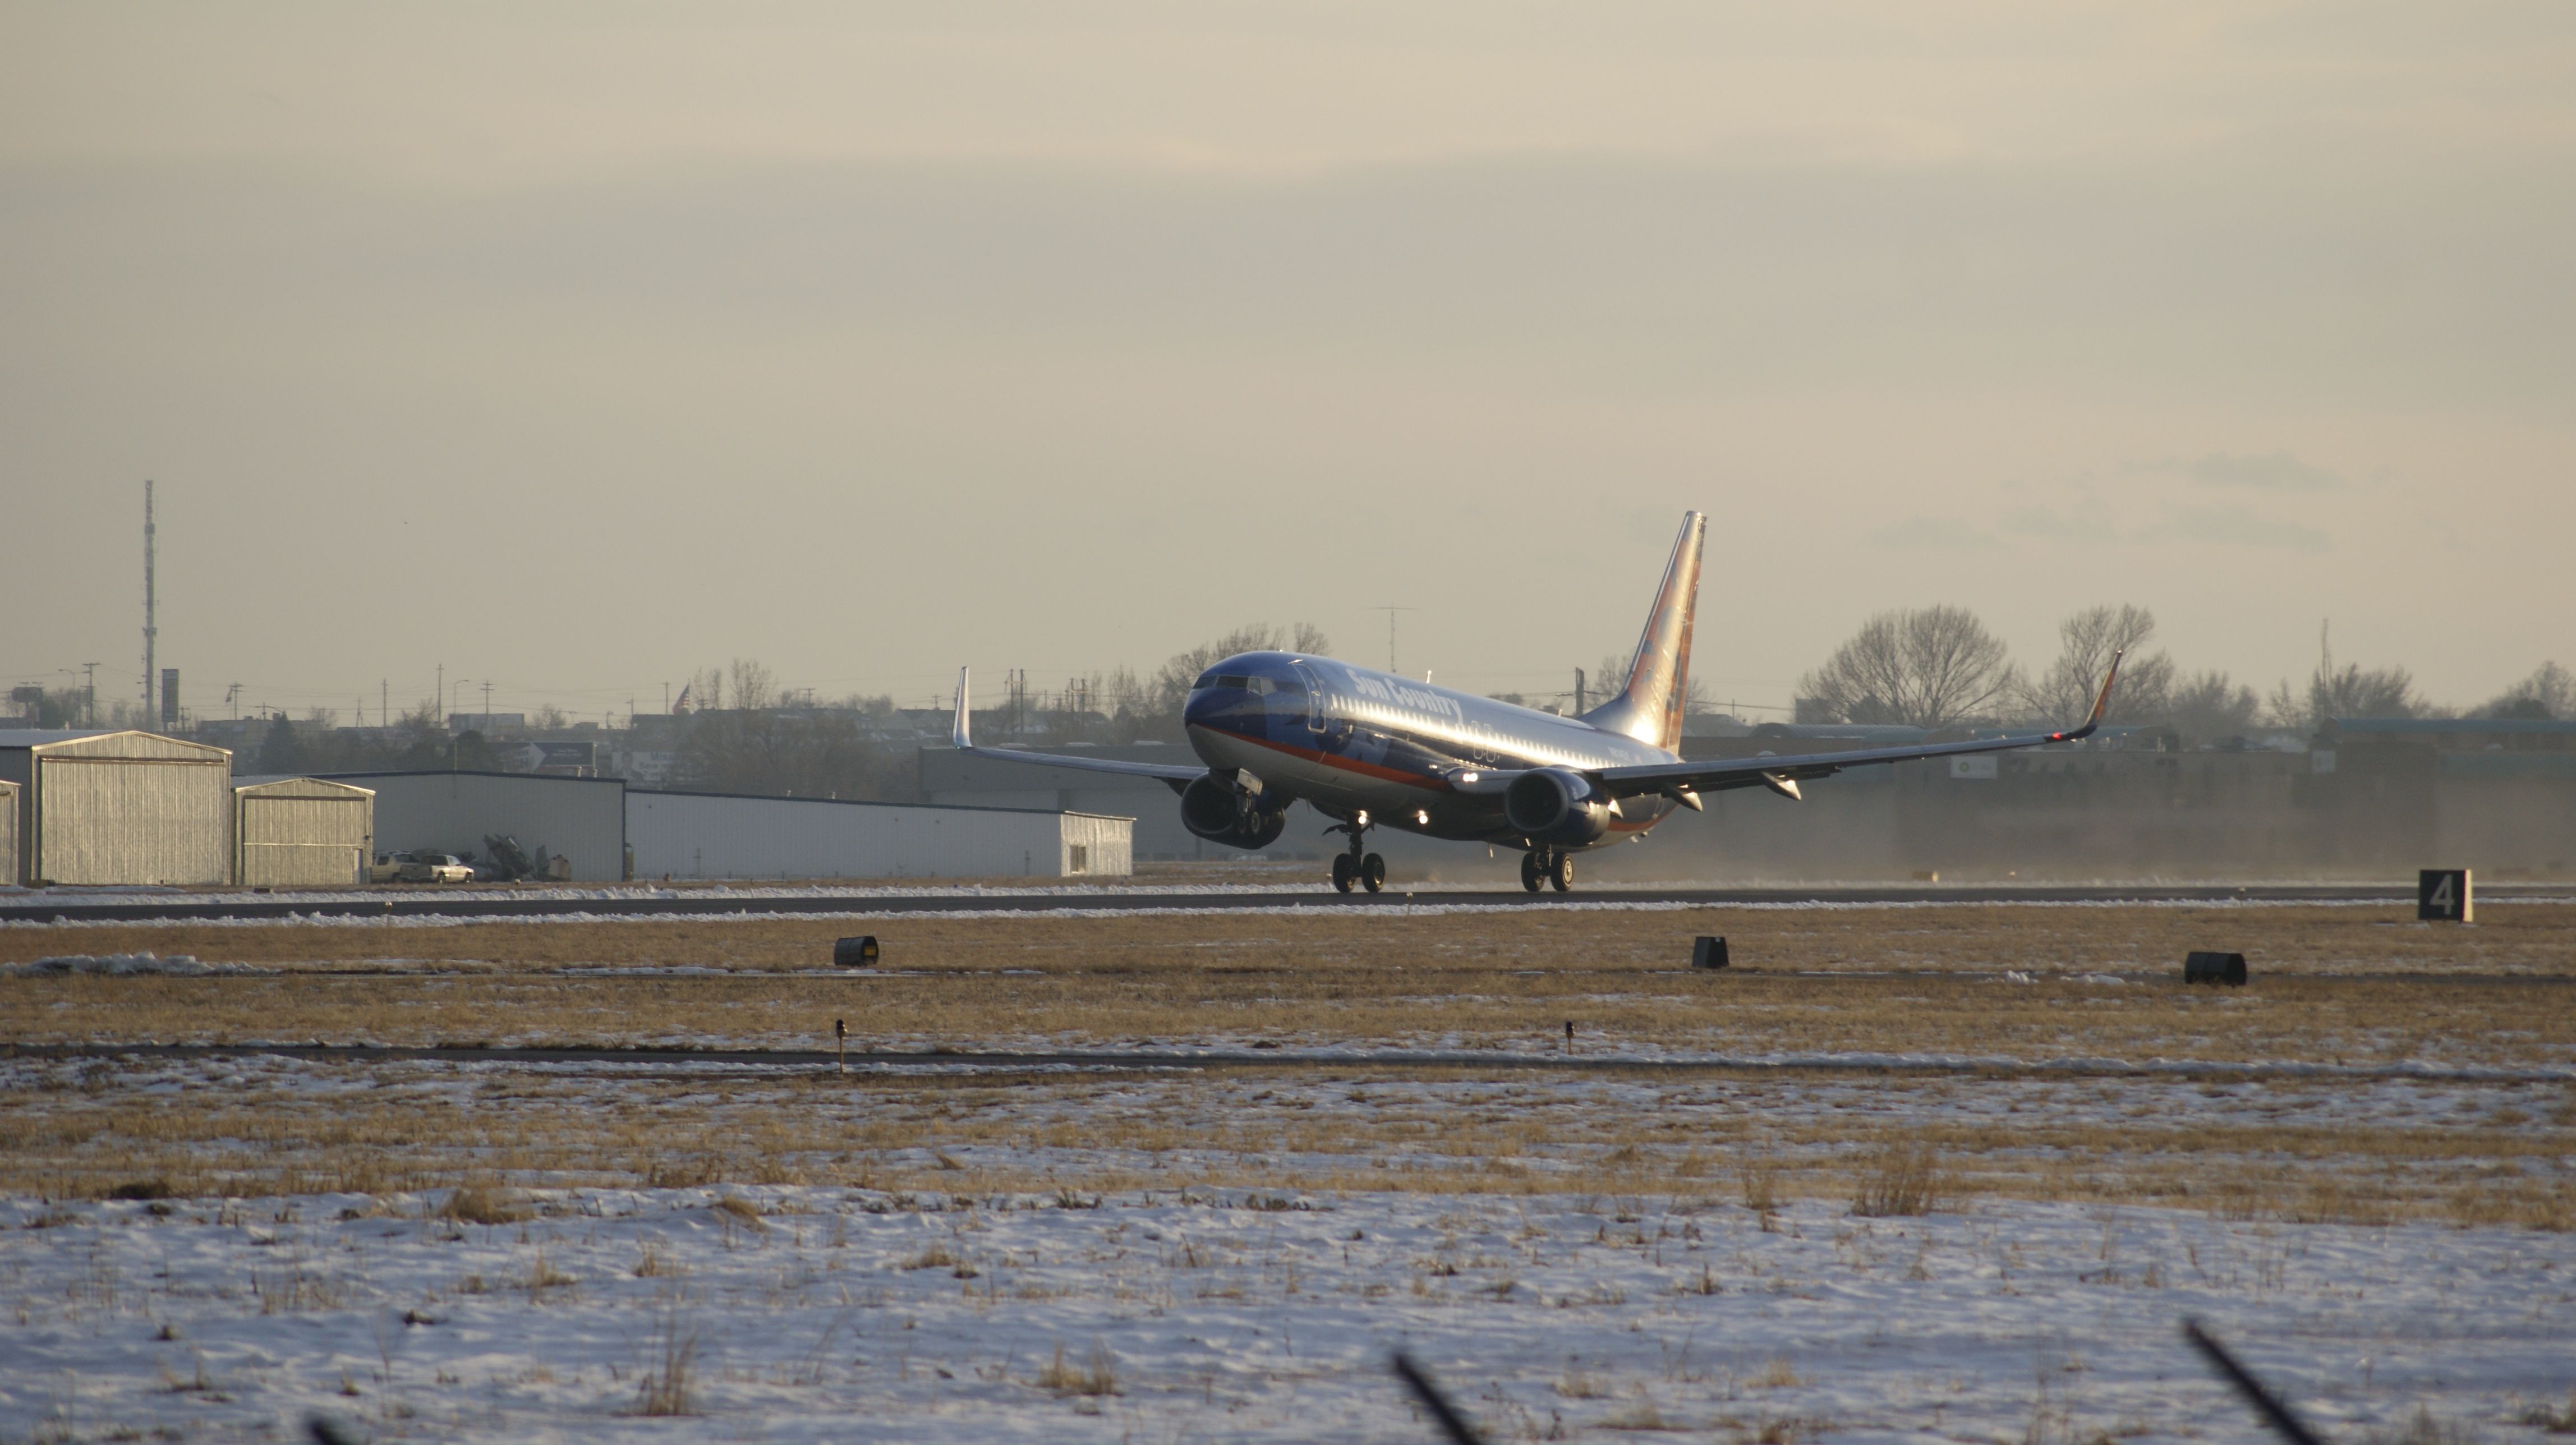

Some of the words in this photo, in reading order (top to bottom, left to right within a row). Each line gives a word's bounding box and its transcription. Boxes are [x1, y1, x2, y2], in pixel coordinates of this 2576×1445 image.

[1346, 669, 1390, 701] Sun
[1384, 677, 1464, 725] Country
[2430, 874, 2454, 915] 4
